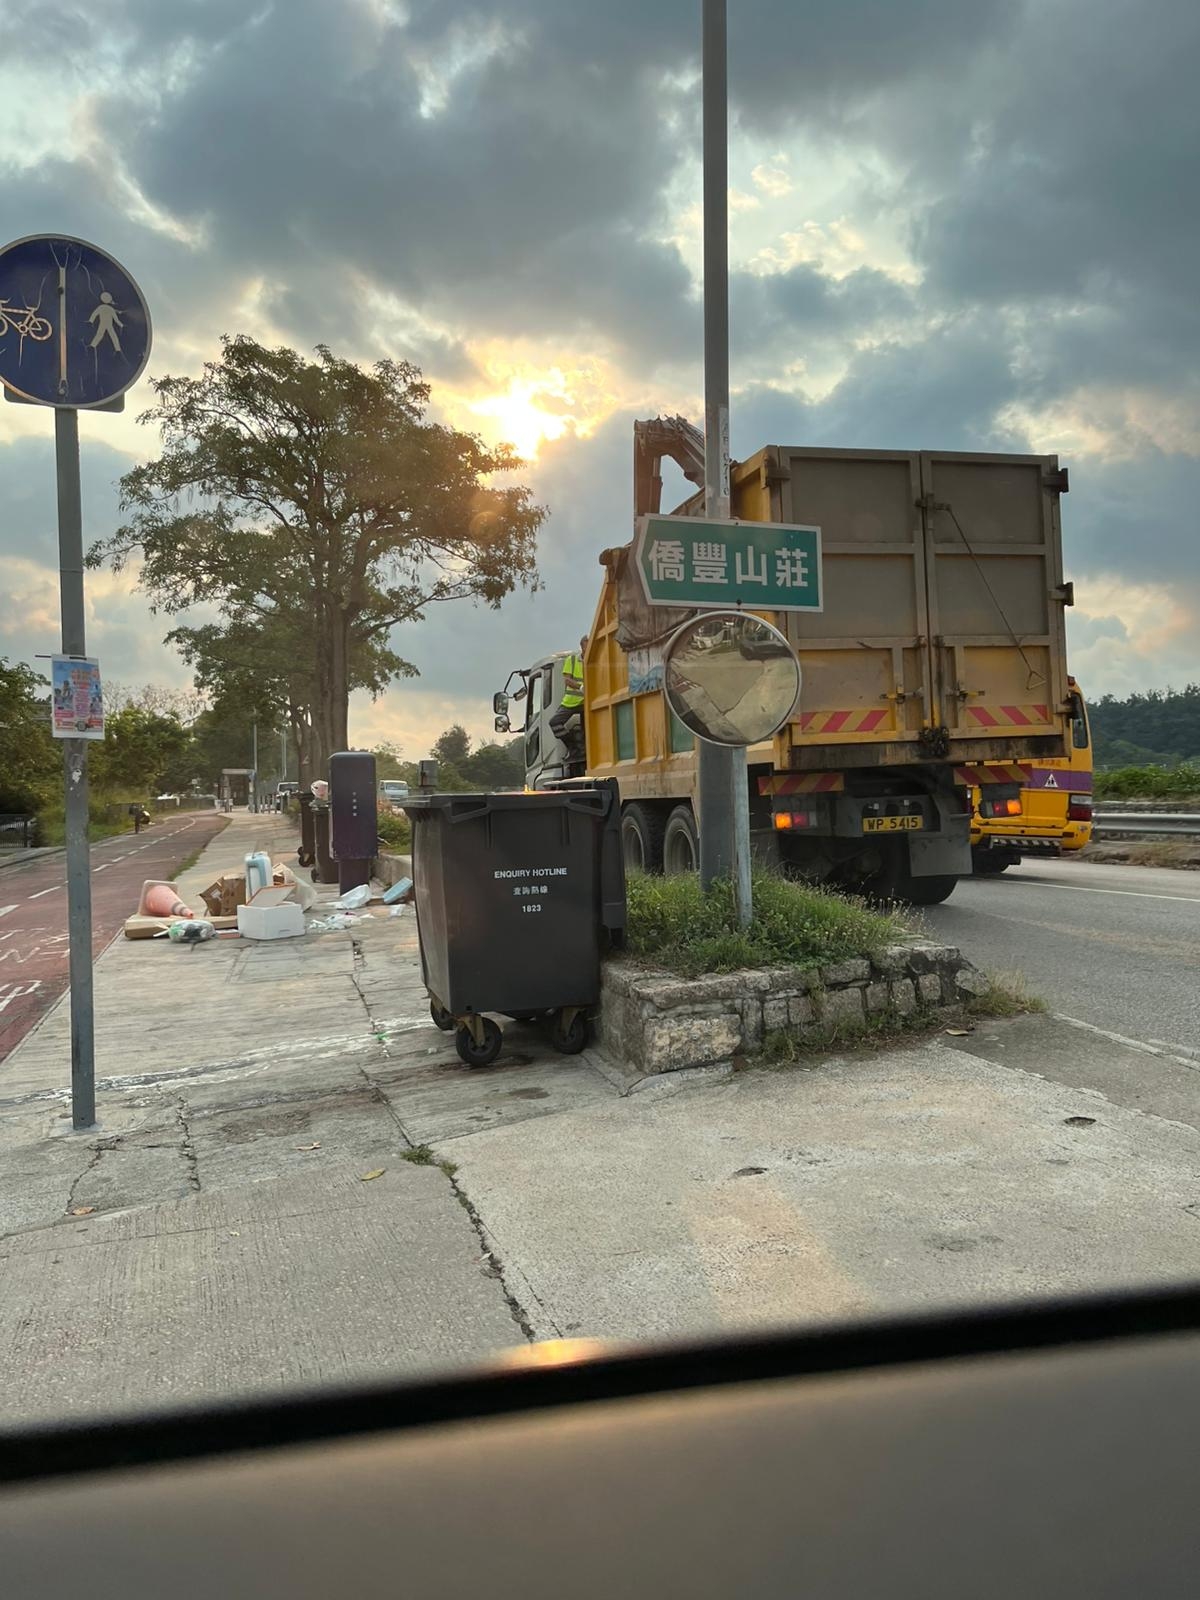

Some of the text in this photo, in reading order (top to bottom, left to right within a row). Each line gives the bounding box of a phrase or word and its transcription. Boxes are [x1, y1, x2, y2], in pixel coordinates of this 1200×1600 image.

[648, 540, 809, 588] 僑豐山莊
[867, 816, 918, 830] WP 5415
[494, 867, 567, 879] ENQUIRY HOTLINE
[522, 904, 542, 913] 1823
